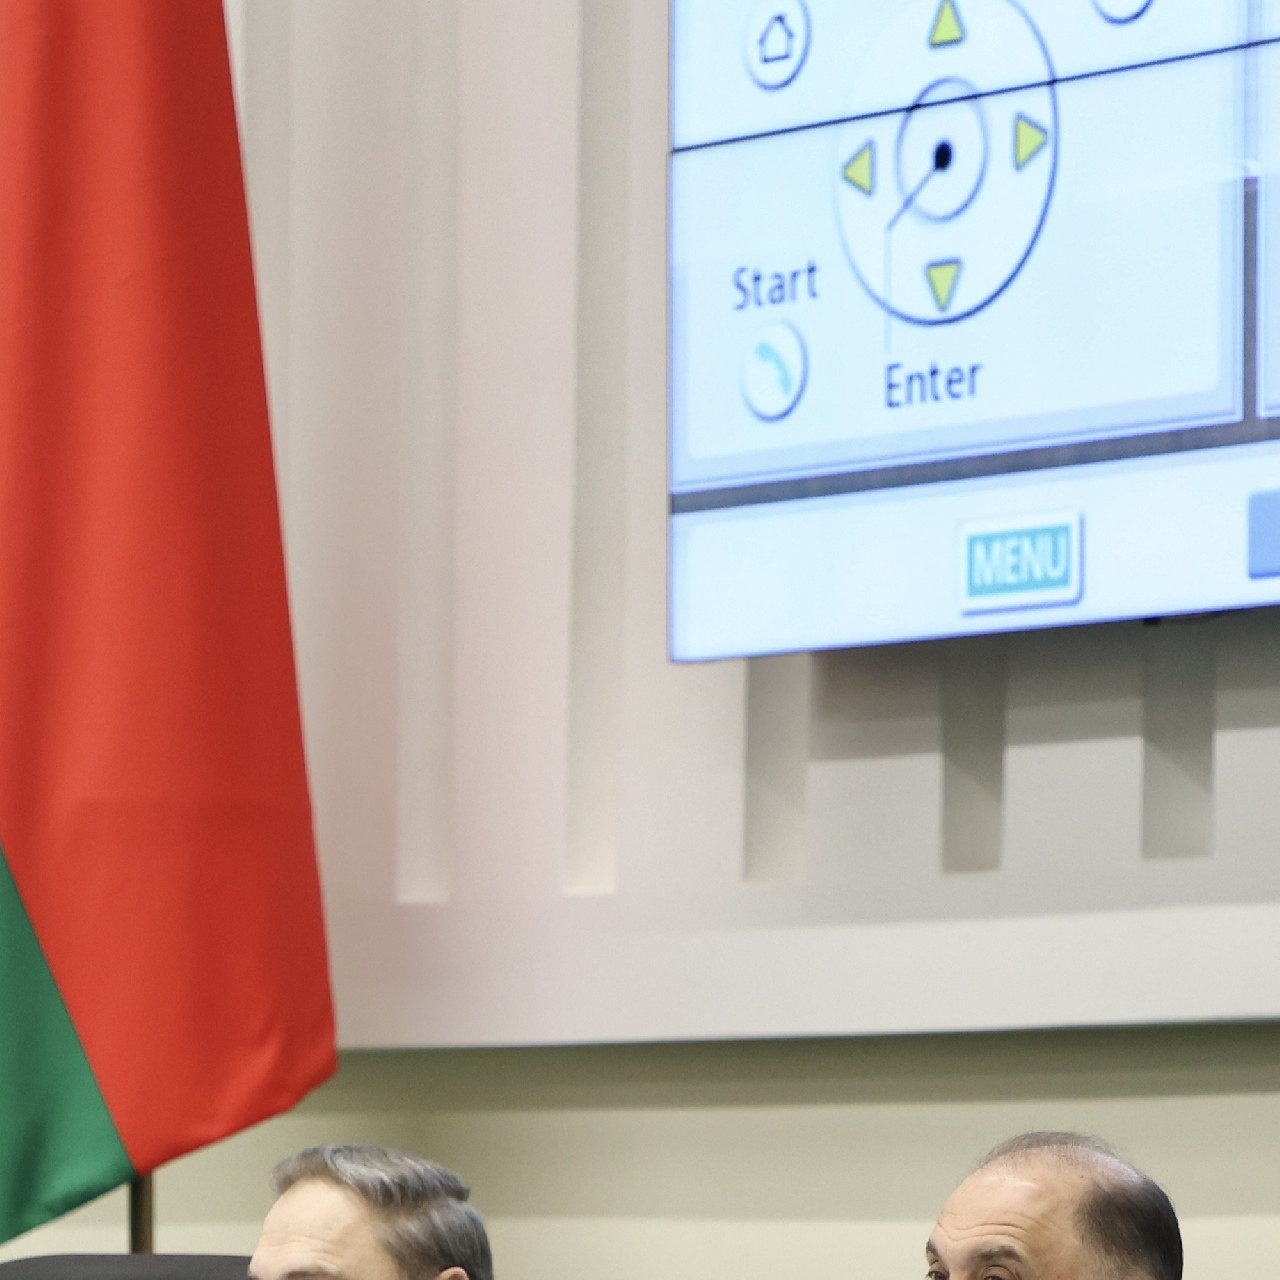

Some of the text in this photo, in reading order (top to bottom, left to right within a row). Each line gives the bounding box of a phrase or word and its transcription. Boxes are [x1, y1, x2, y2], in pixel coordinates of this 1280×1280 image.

[733, 260, 819, 311] Start
[885, 359, 983, 409] Enter
[971, 526, 1069, 588] MENU
